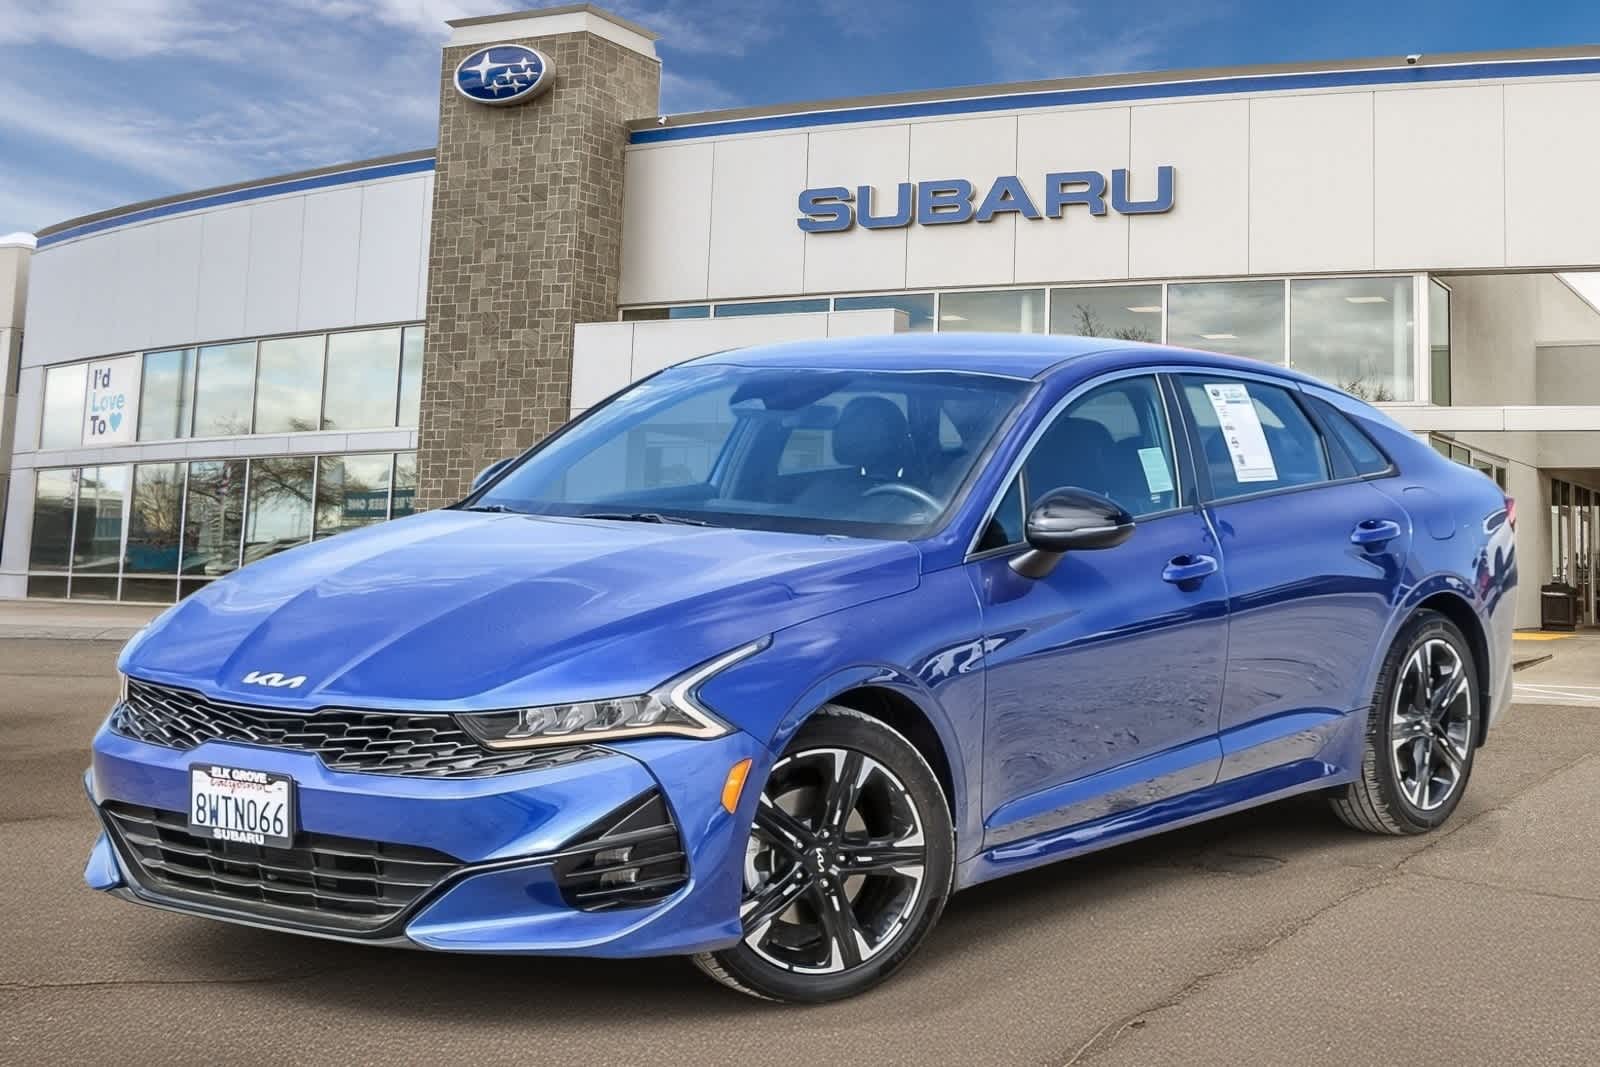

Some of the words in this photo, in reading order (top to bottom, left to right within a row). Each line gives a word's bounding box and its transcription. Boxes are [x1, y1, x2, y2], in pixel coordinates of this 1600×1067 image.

[797, 165, 1176, 233] SUBARU
[93, 368, 111, 389] I'd
[91, 392, 125, 412] Love
[90, 415, 106, 435] To
[211, 766, 231, 779] ELK
[231, 769, 267, 783] GROVE
[196, 793, 284, 835] 8WTN066
[213, 828, 264, 845] SUBARU
